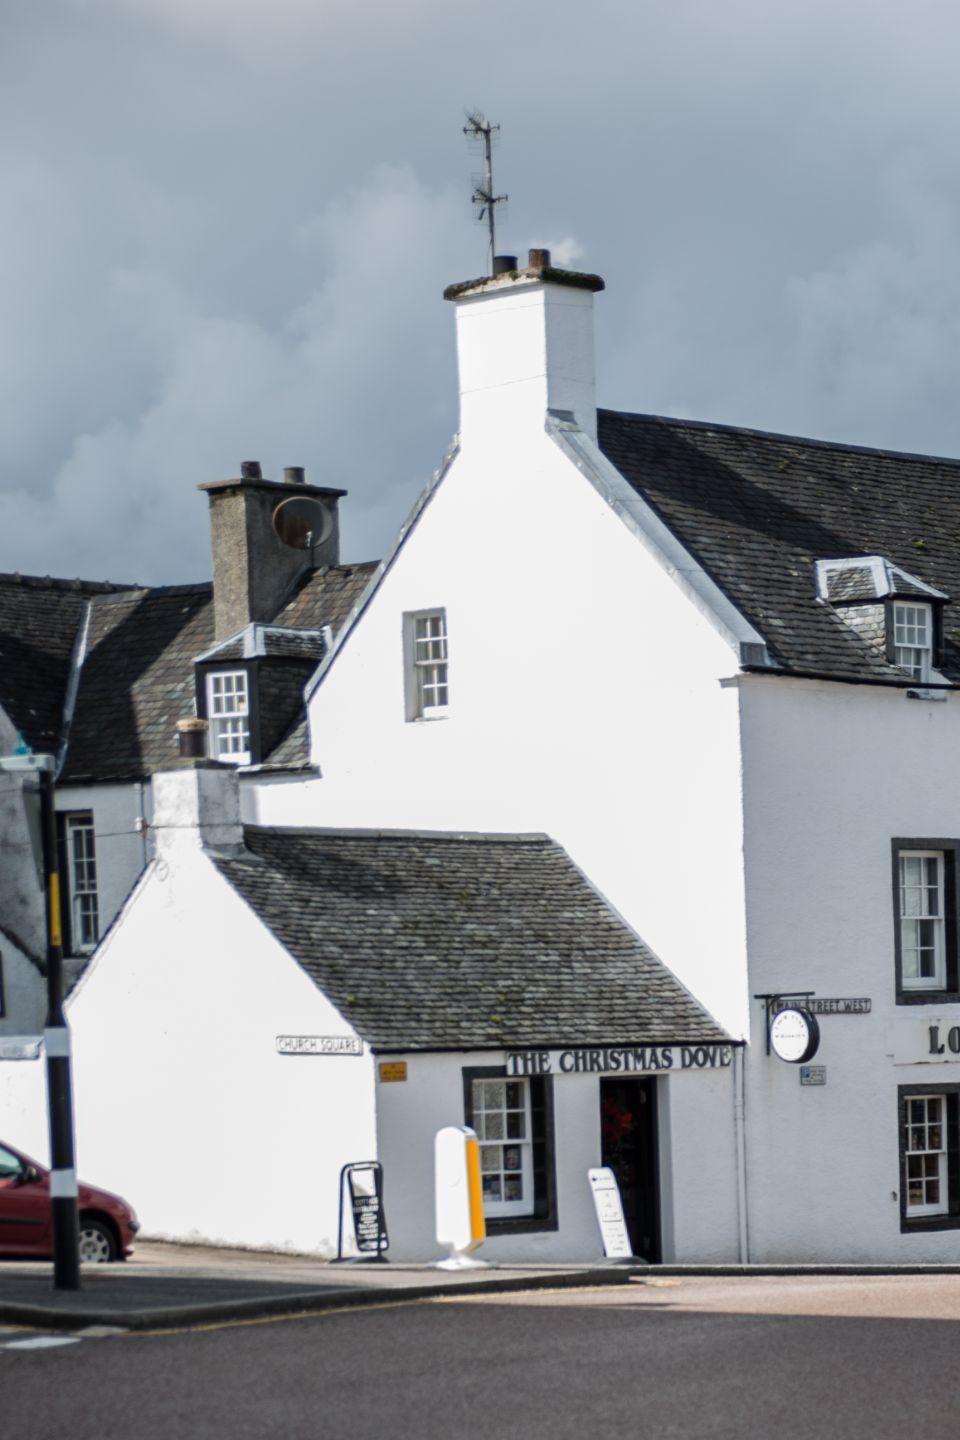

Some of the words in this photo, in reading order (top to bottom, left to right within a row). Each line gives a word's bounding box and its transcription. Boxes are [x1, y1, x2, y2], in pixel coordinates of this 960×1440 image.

[806, 1000, 840, 1011] STREET
[844, 1000, 869, 1011] WEST
[279, 1039, 317, 1051] CHURCH
[320, 1040, 357, 1052] SQUARE
[508, 1052, 551, 1075] THE
[559, 1047, 673, 1073] CHRISTMAS
[680, 1045, 732, 1068] DOVE
